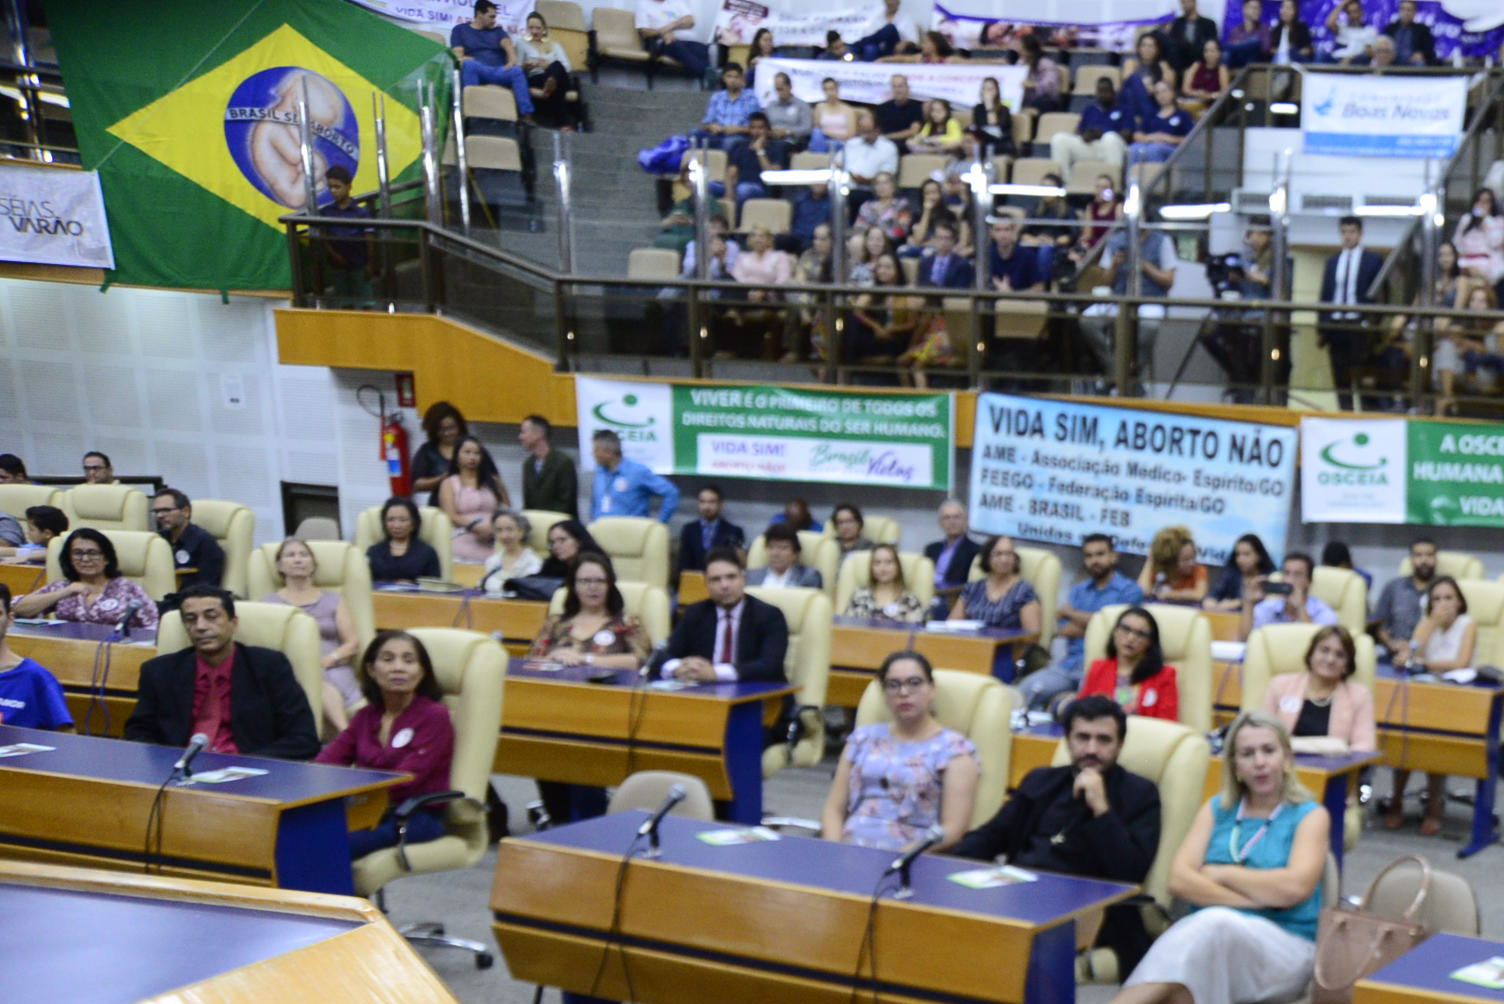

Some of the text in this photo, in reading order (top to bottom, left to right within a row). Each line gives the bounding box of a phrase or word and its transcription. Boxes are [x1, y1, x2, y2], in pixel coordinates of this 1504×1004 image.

[229, 108, 280, 120] BRASIL
[1342, 103, 1451, 120] Boas Novas
[9, 215, 83, 236] VARÃO
[690, 389, 741, 407] VIVER
[755, 393, 769, 409] O
[769, 395, 838, 413] PRIMEIRO
[842, 399, 862, 414] DE
[864, 399, 914, 417] TODOS
[915, 402, 938, 418] OS
[682, 411, 746, 429] DIREITOS
[747, 414, 817, 432] NATURAIS
[819, 418, 841, 433] DO
[844, 420, 871, 435] SER
[711, 441, 747, 455] VIDA
[989, 405, 1283, 468] VIDA SIM, ABORTO NÃO
[1439, 433, 1456, 453] A
[983, 445, 1016, 463] AME
[1031, 451, 1120, 478] Associação
[1413, 461, 1504, 484] HUMANA
[980, 468, 1034, 489] FEEGO
[1048, 475, 1129, 503] Federação
[1317, 471, 1389, 486] OSCEIA
[979, 493, 1014, 512] AME
[1029, 498, 1084, 521] BRASIL
[1101, 508, 1131, 527] FEB
